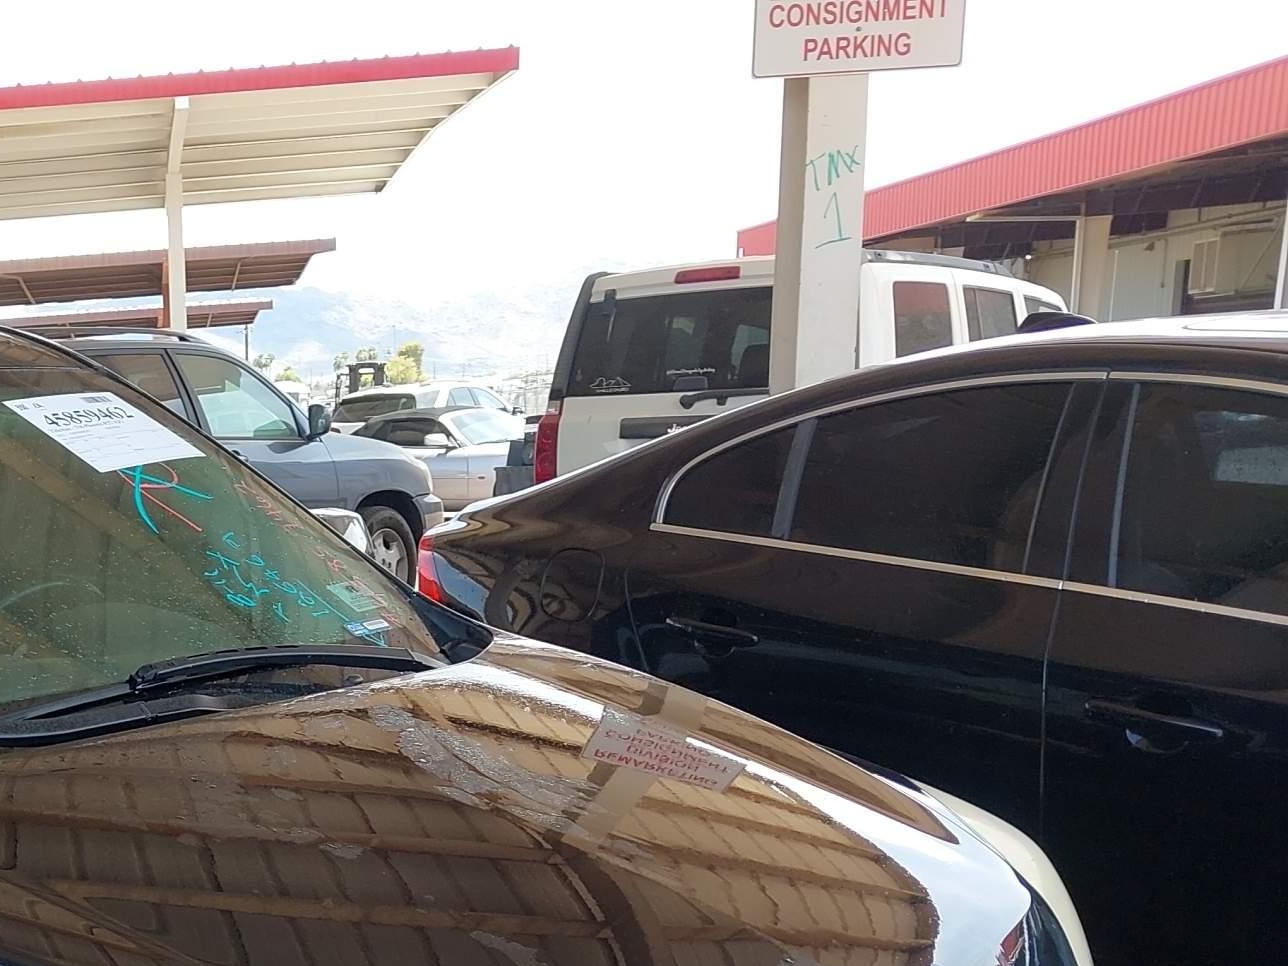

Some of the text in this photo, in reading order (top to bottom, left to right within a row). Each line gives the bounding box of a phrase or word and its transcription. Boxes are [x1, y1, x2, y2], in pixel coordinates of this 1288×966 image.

[769, 0, 946, 28] CONSIGNMENT
[802, 33, 911, 61] PARKING
[816, 192, 852, 248] 1
[43, 406, 134, 428] 45859462
